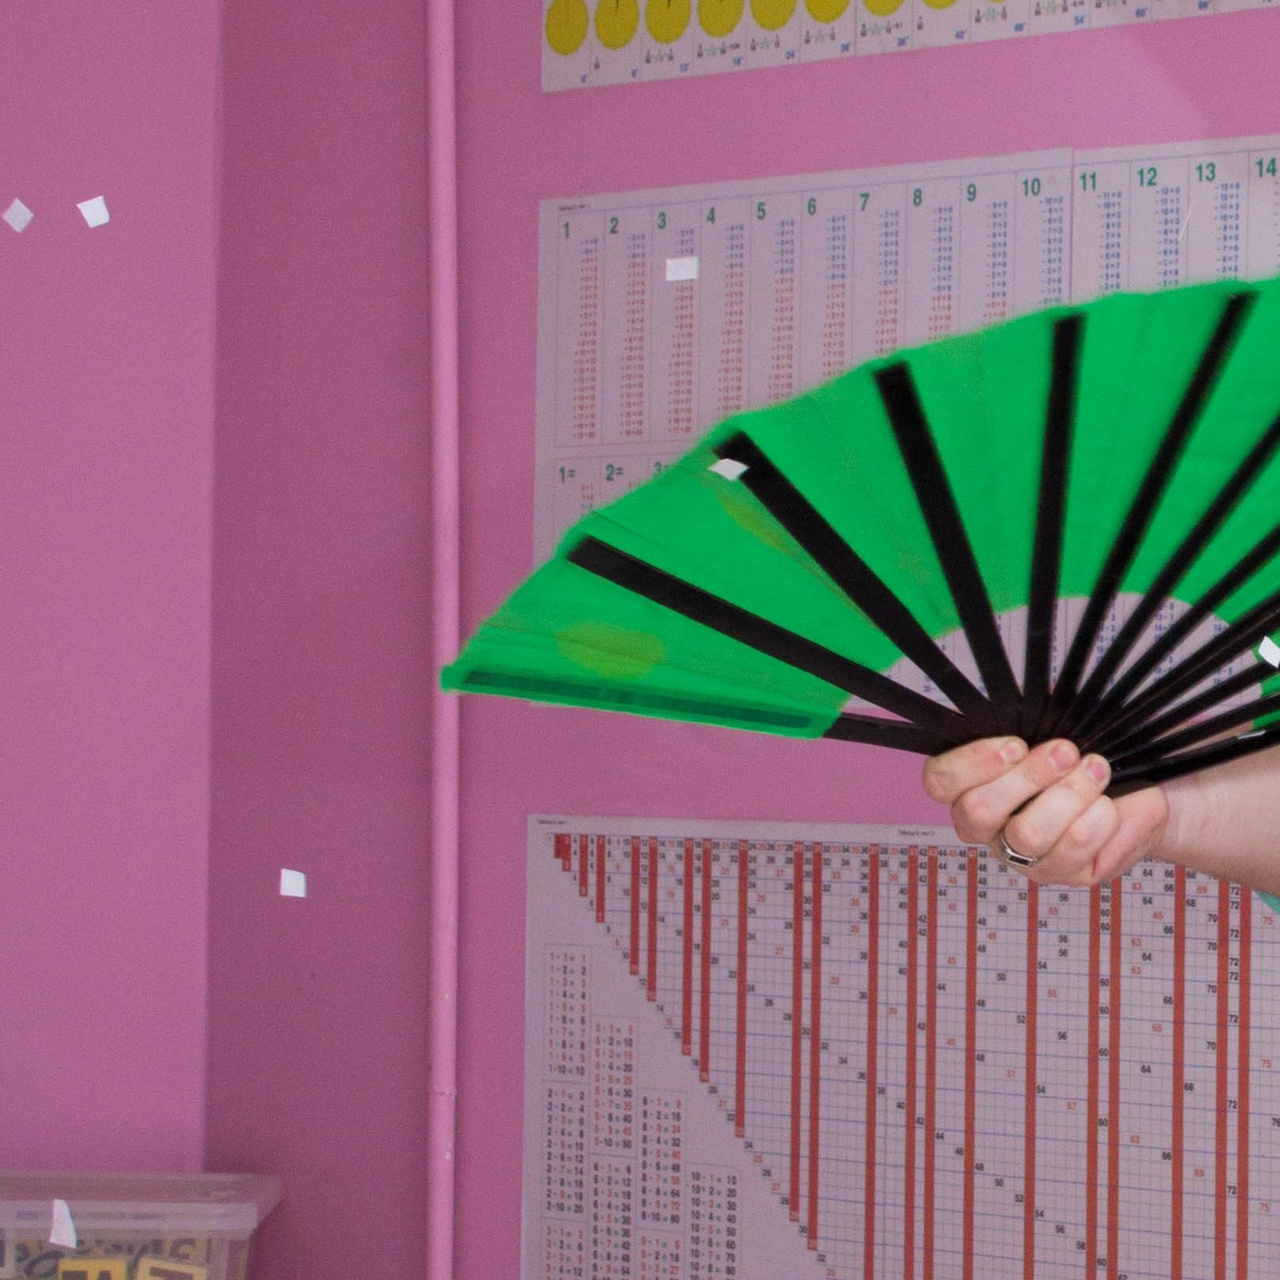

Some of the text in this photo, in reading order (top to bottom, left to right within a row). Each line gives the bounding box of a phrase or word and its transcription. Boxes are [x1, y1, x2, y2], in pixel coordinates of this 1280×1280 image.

[563, 223, 570, 238] 1
[610, 218, 618, 234] 2
[657, 212, 666, 229] 3
[707, 208, 715, 224] 4
[757, 202, 766, 220] 5
[808, 198, 816, 215] 6
[860, 194, 869, 212] 7
[913, 189, 922, 207] 8
[967, 184, 977, 202] 9
[1022, 178, 1041, 197] 10
[1080, 173, 1098, 192] 11
[1137, 167, 1157, 187] 12
[1196, 163, 1216, 183] 13
[1256, 157, 1277, 178] 14
[1143, 869, 1174, 878] 64 66
[1142, 897, 1152, 905] 64
[1186, 898, 1196, 907] 68
[1208, 914, 1217, 923] 70
[1229, 929, 1239, 938] 72
[1207, 942, 1217, 951] 70
[1229, 958, 1239, 966] 72
